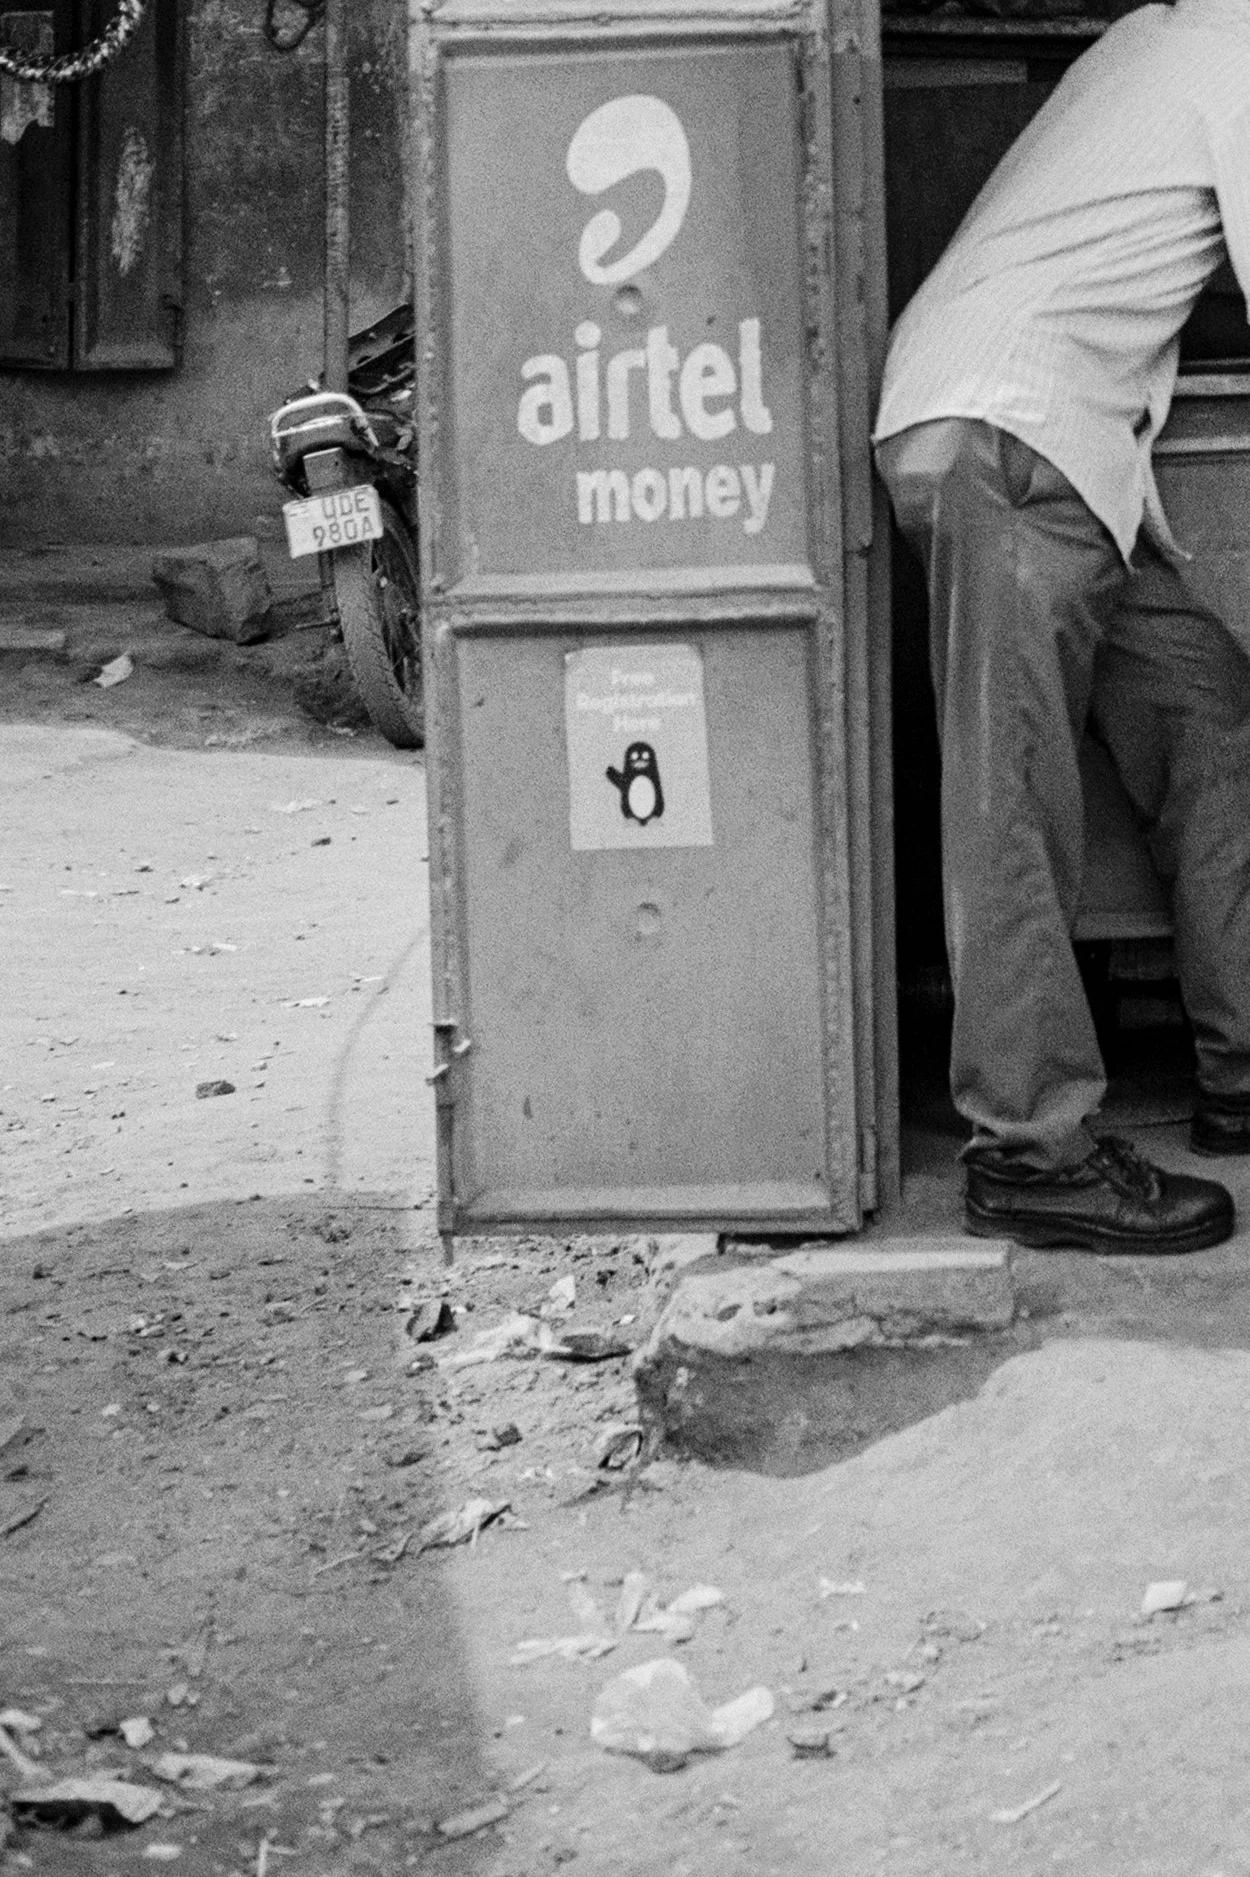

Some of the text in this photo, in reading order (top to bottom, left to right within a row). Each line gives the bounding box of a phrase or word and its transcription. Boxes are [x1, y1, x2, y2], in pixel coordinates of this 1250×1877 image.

[517, 318, 773, 446] airtel
[322, 491, 370, 520] UDE
[576, 462, 775, 534] money
